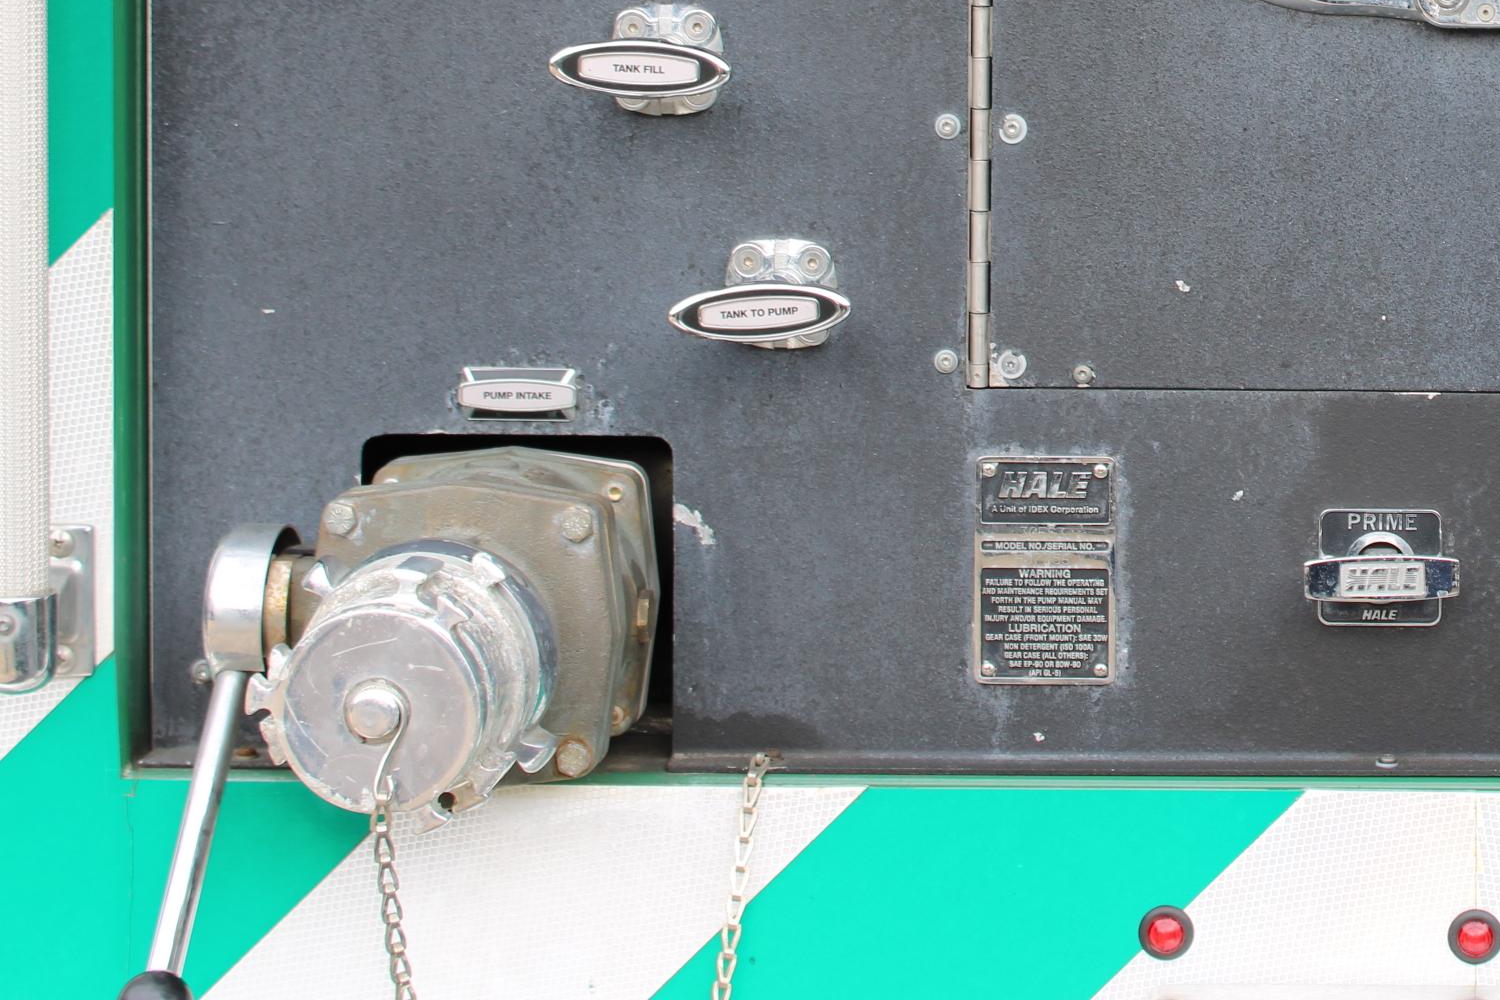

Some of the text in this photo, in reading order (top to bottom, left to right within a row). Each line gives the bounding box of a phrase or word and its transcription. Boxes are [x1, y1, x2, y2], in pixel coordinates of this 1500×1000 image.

[612, 64, 664, 74] TANK FILL
[720, 306, 798, 320] TANK TO PUMP
[483, 390, 552, 400] PUMP INTAKE
[998, 471, 1093, 499] HALE
[1050, 506, 1099, 514] Corporation
[1348, 513, 1418, 530] PRIME
[995, 542, 1026, 550] MODEL
[1079, 542, 1096, 550] NO.
[1018, 569, 1071, 578] WARNING
[1096, 588, 1108, 596] SET
[991, 596, 1012, 604] FORTH
[1023, 596, 1036, 604] THE
[1038, 596, 1056, 604] PUMP
[1062, 606, 1098, 614] PERSONAL
[1362, 610, 1398, 620] HALE
[1008, 624, 1082, 633] LUBRICATION
[1078, 634, 1092, 642] SAE
